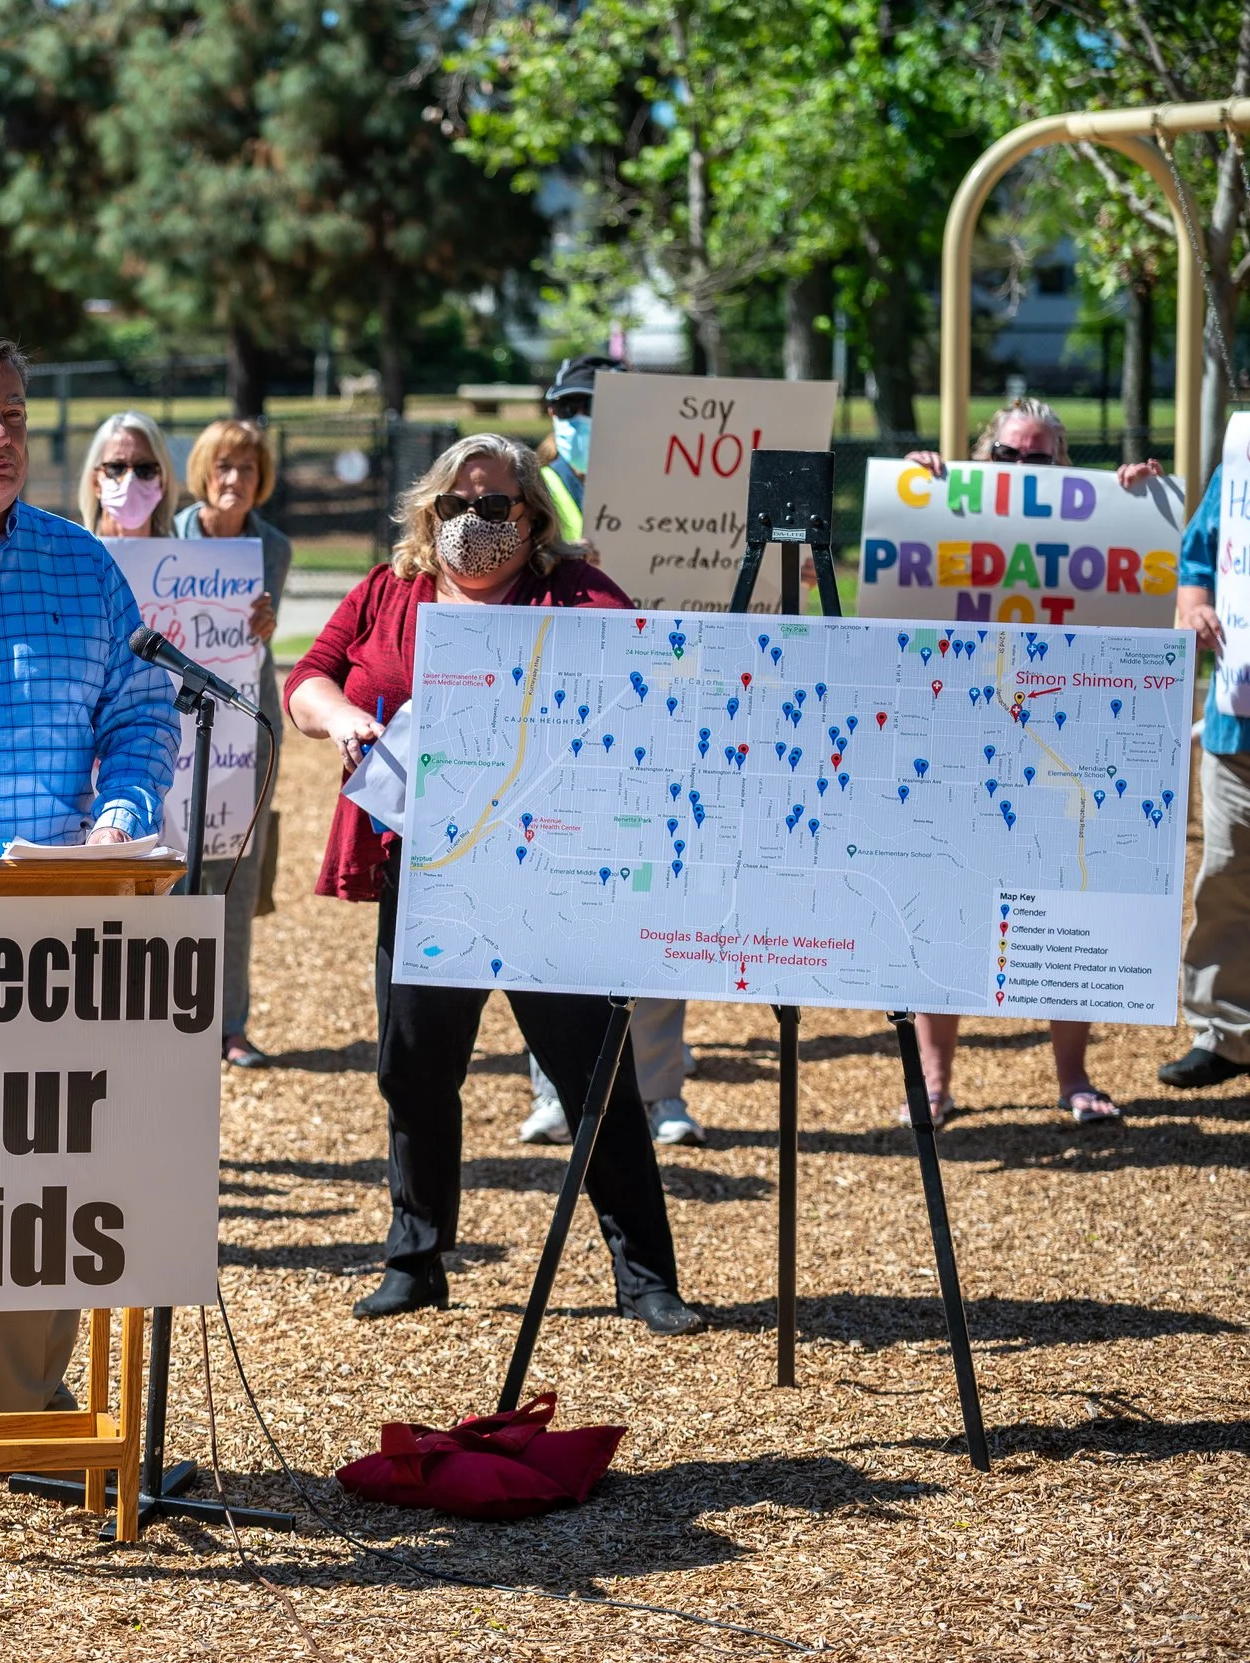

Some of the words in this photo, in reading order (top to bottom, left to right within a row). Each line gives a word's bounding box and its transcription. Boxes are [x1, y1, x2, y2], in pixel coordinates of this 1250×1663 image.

[679, 397, 734, 434] say
[897, 467, 1096, 521] CHILD
[595, 505, 621, 531] to
[638, 511, 746, 547] sexually
[864, 539, 1178, 595] PREDATORS
[152, 554, 263, 600] Gardner
[956, 592, 1075, 625] NOT
[689, 678, 718, 687] Cajon
[1016, 671, 1066, 686] Simon
[1072, 673, 1137, 691] Shimon,
[1143, 675, 1176, 690] SVP
[504, 716, 536, 724] CAJON
[540, 717, 581, 726] HEIGHTS
[1047, 770, 1083, 778] Elementary
[875, 850, 909, 858] Elementary
[999, 892, 1018, 902] Map
[1019, 893, 1036, 903] Key
[1012, 908, 1047, 917] Offender
[1011, 925, 1046, 934] Offender
[1048, 927, 1055, 935] in
[1057, 927, 1090, 936] Violation
[640, 928, 692, 944] Douglas
[695, 931, 740, 946] Badger
[753, 934, 789, 947] Merle
[793, 936, 855, 951] Wakefield
[1010, 942, 1044, 953] Sexually
[1045, 944, 1073, 953] Violent
[1074, 946, 1108, 955] Predator
[664, 948, 716, 964] Sexually
[719, 951, 764, 964] Violent
[767, 953, 828, 967] Predators
[1009, 960, 1043, 971] Sexually
[1045, 962, 1072, 971] Violent
[1073, 963, 1107, 972] Predator
[1109, 965, 1116, 973] in
[1118, 965, 1152, 975] Violation
[1008, 977, 1039, 987] Multiple
[1040, 979, 1079, 989] Offenders
[1081, 981, 1089, 989] at
[1090, 981, 1124, 991] Location
[1007, 995, 1038, 1004] Multiple
[1039, 997, 1078, 1006] Offenders
[1080, 999, 1088, 1007] at
[1089, 999, 1125, 1009] Location,
[1127, 1001, 1145, 1010] One
